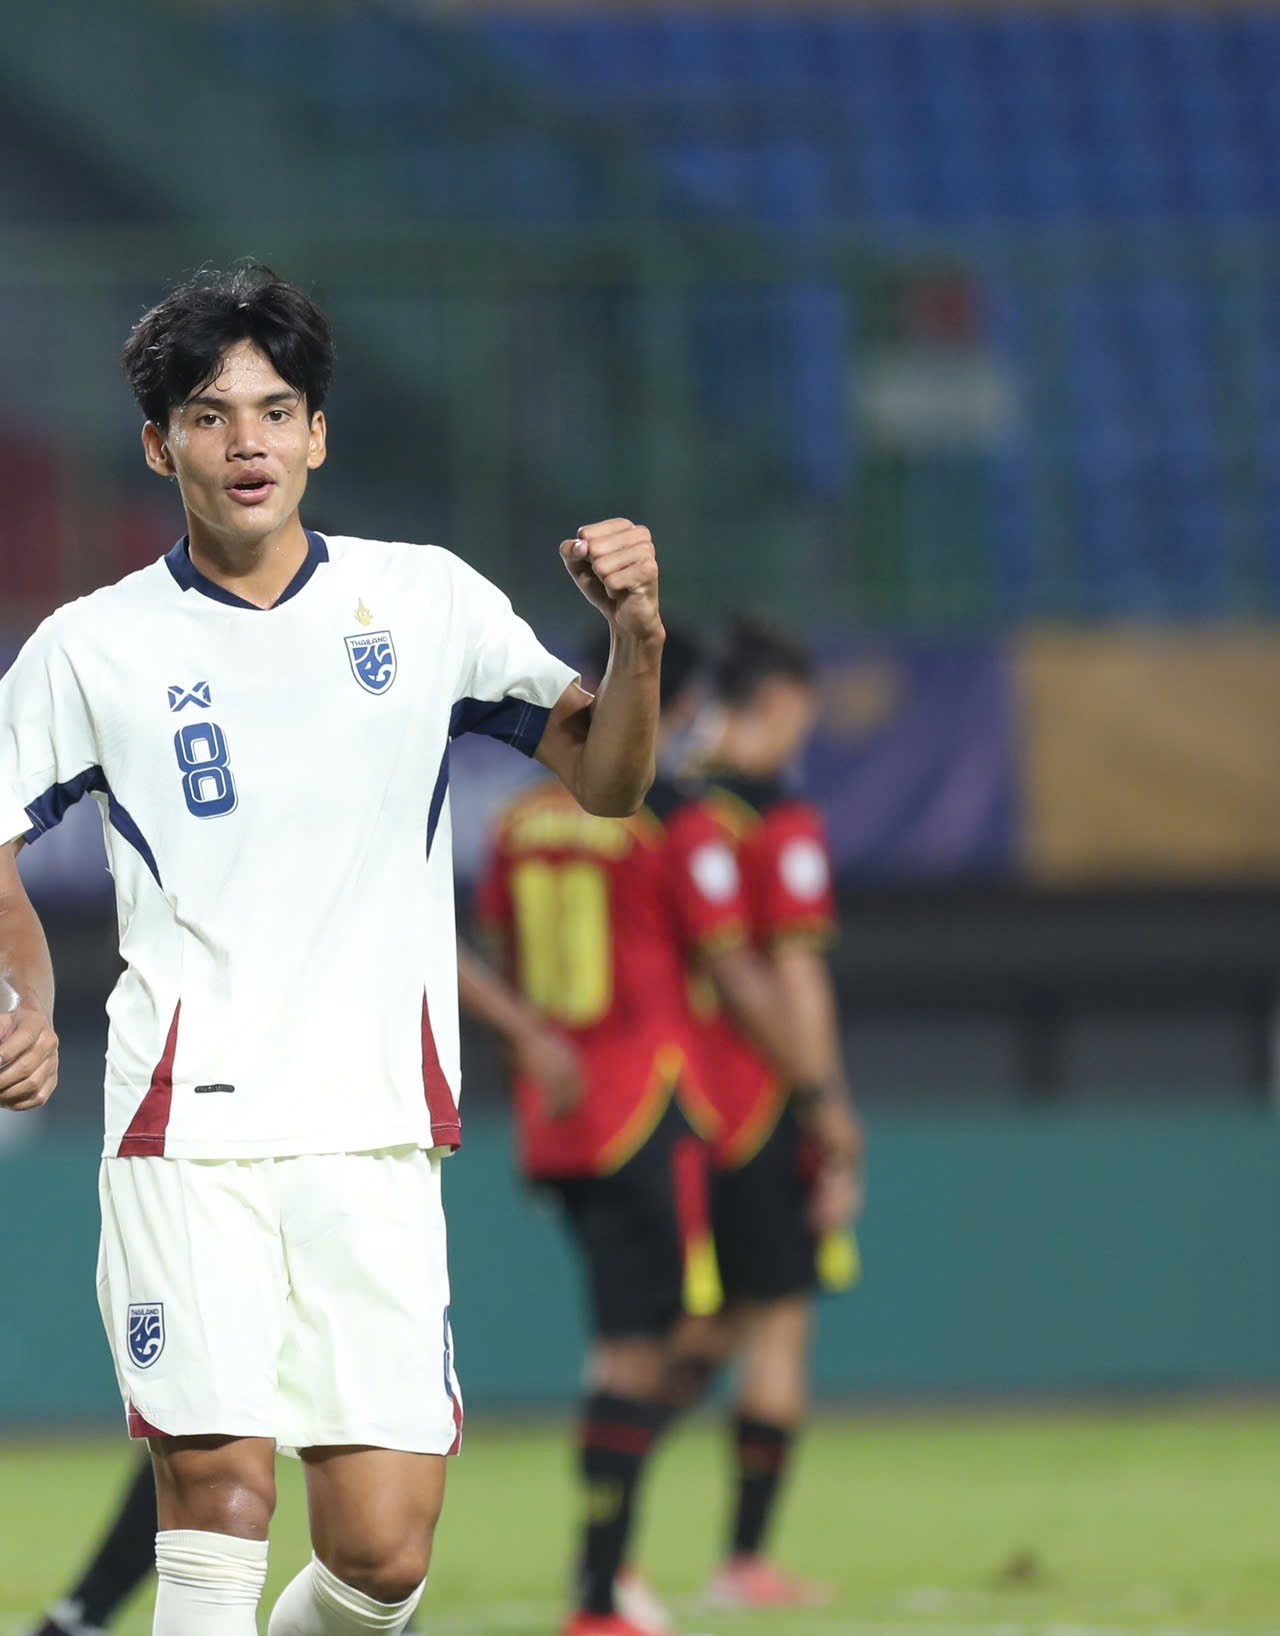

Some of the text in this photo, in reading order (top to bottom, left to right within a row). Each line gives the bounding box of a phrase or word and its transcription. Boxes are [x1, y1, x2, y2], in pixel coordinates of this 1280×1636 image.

[350, 636, 388, 647] THAILAND
[174, 722, 238, 819] 8
[130, 1308, 160, 1316] THAILAND
